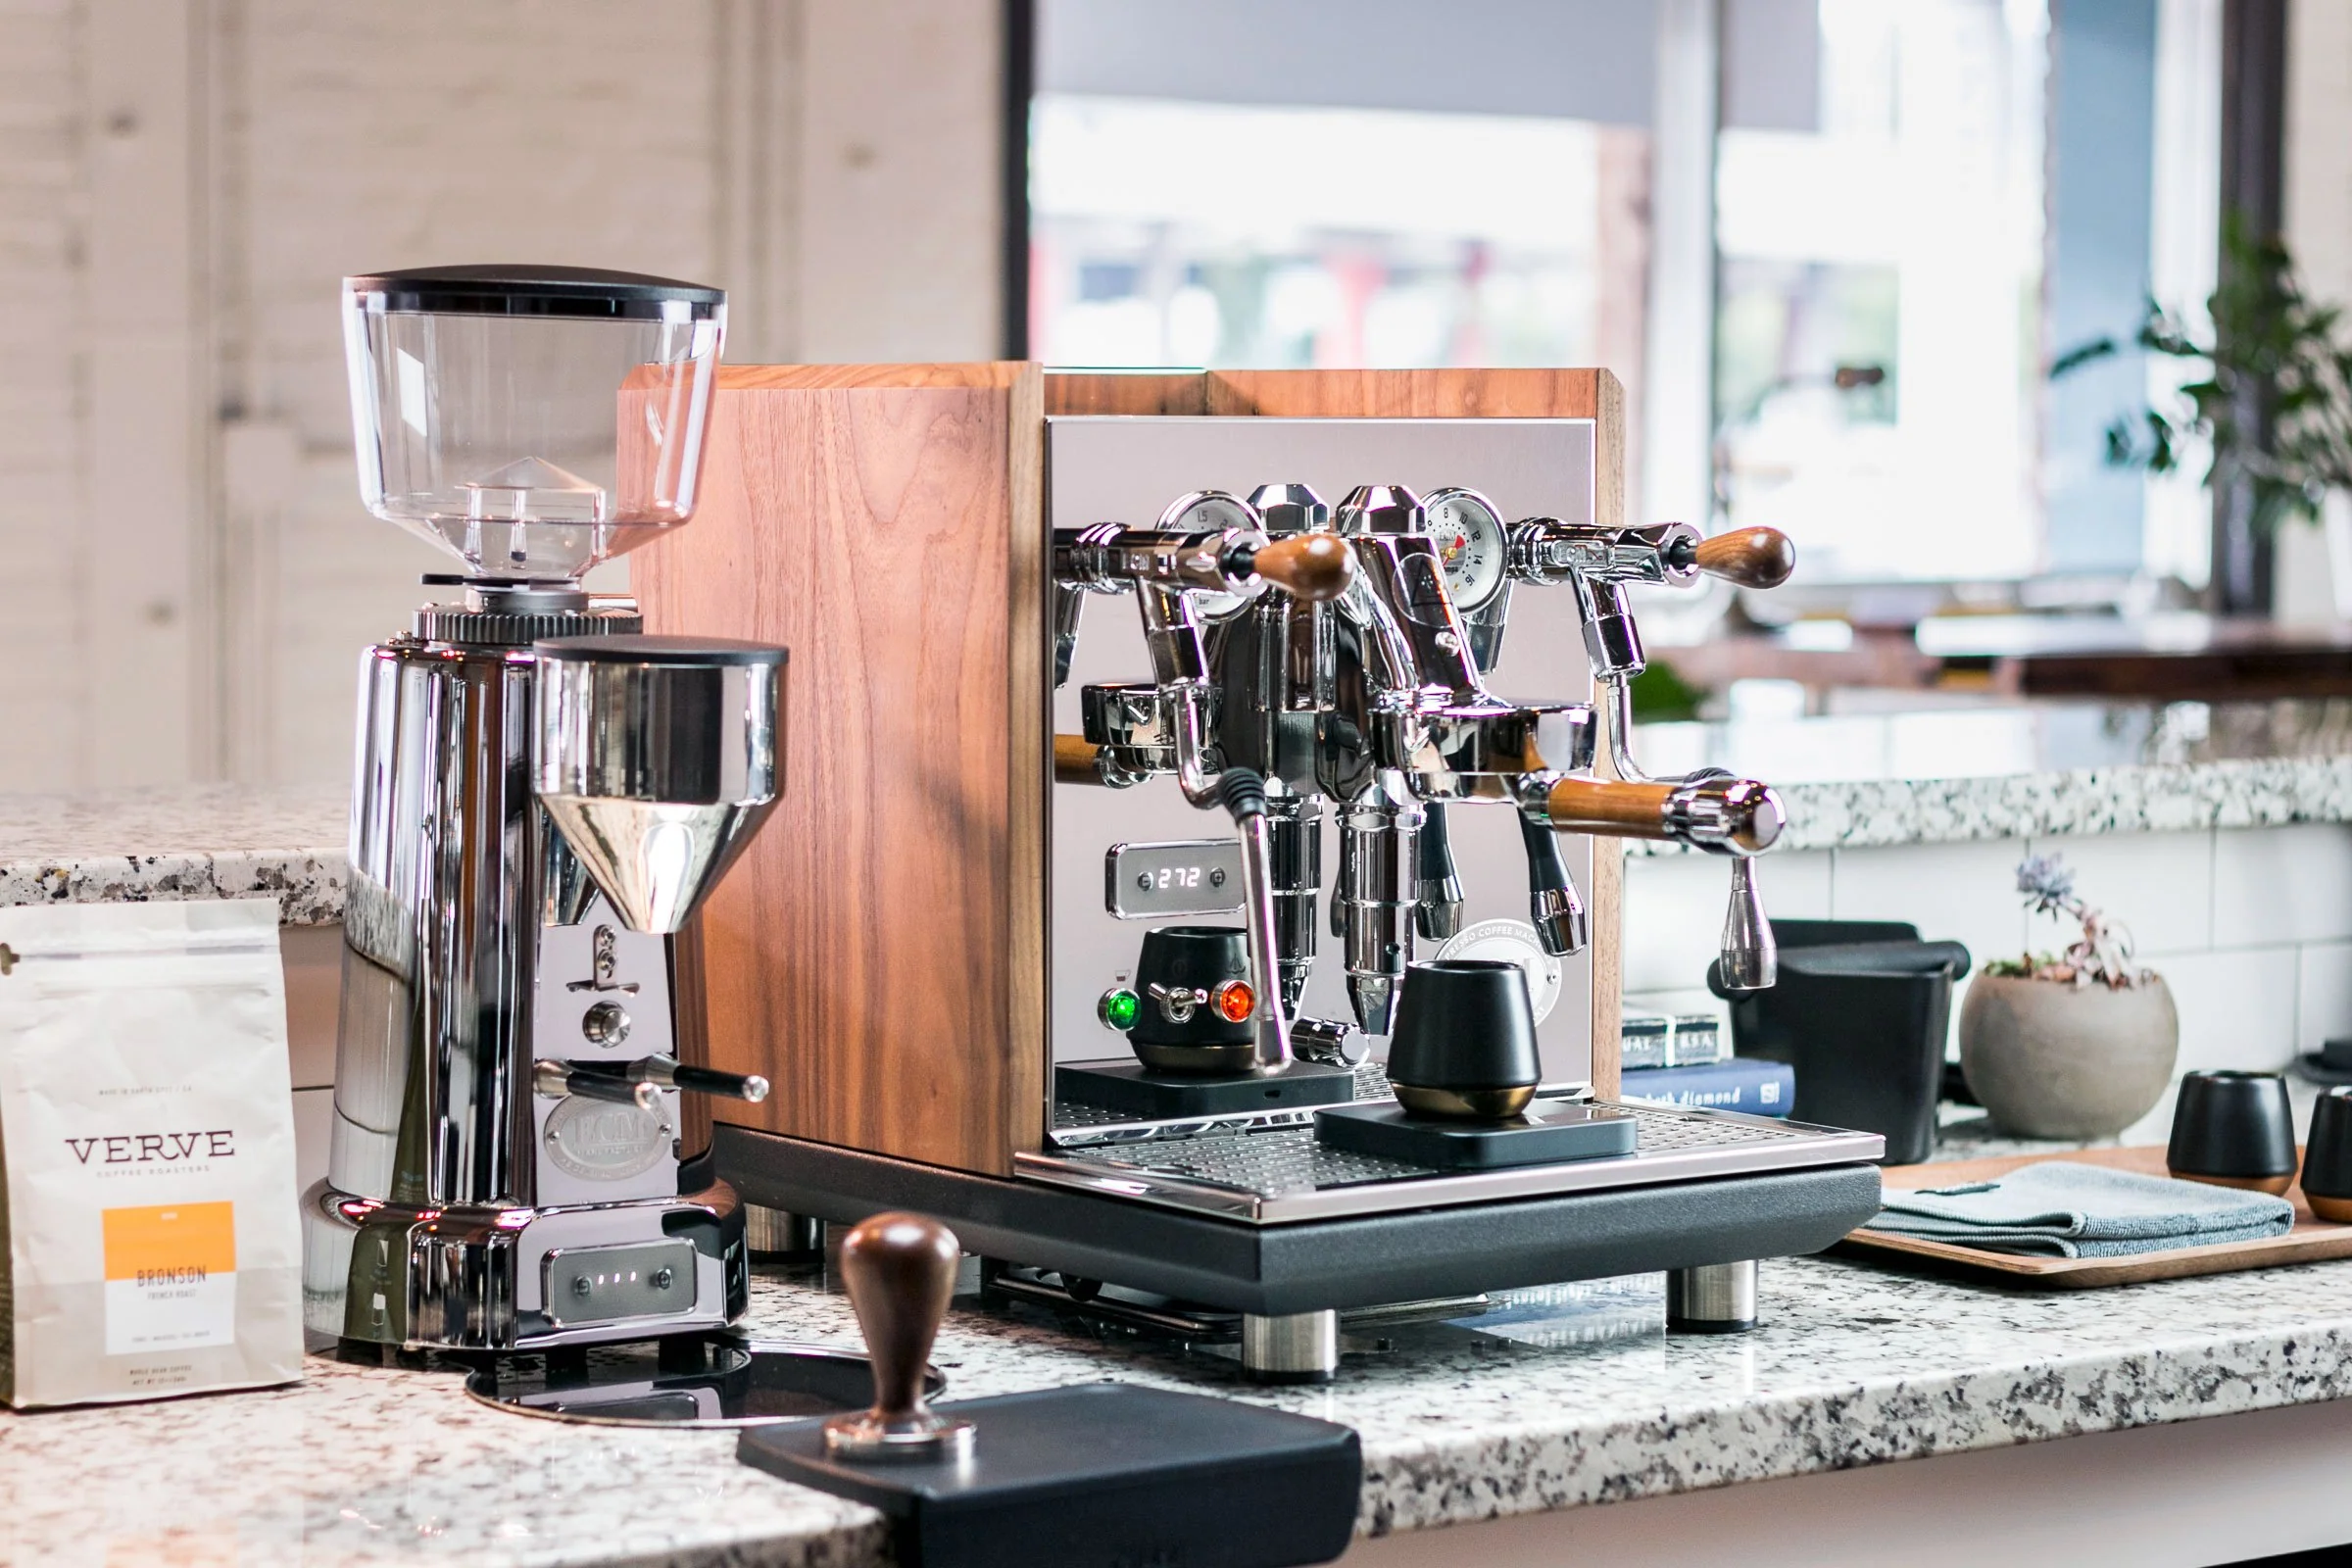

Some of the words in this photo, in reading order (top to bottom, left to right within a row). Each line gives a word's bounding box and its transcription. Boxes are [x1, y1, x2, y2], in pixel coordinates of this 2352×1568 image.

[1444, 508, 1448, 518] 8
[1458, 512, 1469, 525] 10
[1471, 530, 1482, 543] 12
[1473, 555, 1483, 565] 14
[1464, 573, 1476, 587] 16
[1158, 867, 1200, 889] 272
[1478, 926, 1513, 937] COFFEE
[65, 1130, 235, 1164] VERVE
[149, 1164, 211, 1175] ROASTERS
[136, 1264, 207, 1288] BRONSON
